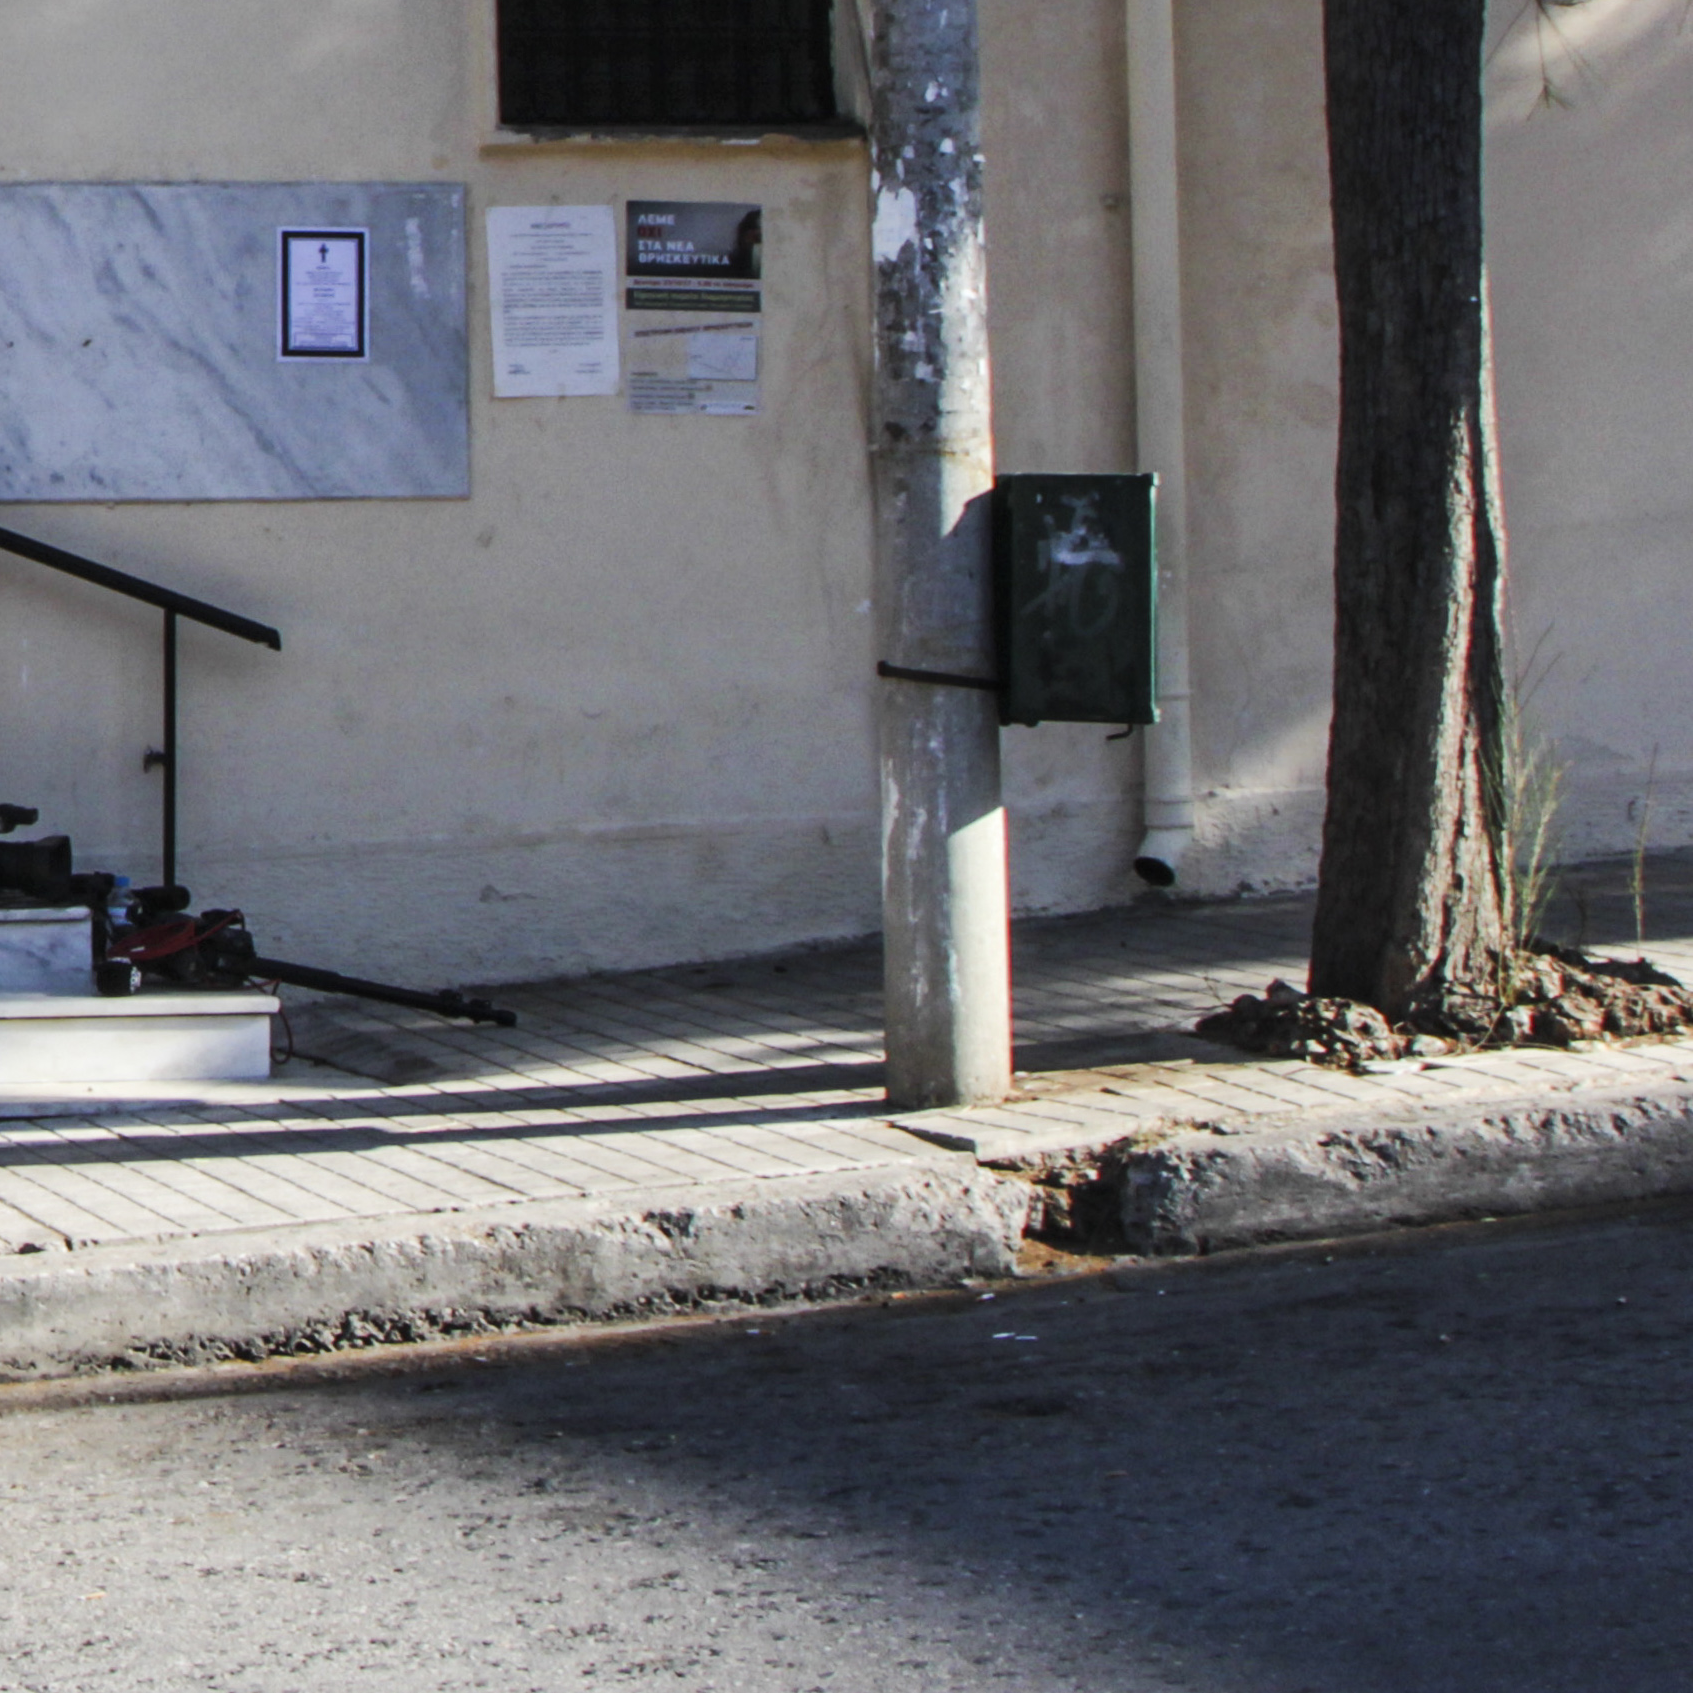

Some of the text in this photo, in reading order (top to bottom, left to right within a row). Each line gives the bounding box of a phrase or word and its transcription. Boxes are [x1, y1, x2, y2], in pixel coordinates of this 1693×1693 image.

[637, 213, 676, 226] ΛΕΜΕ
[637, 240, 695, 253] ΣΤΑ ΝΕΑ
[637, 253, 731, 265] ΘΡΗΣΚΕΥΤΙΚΑ
